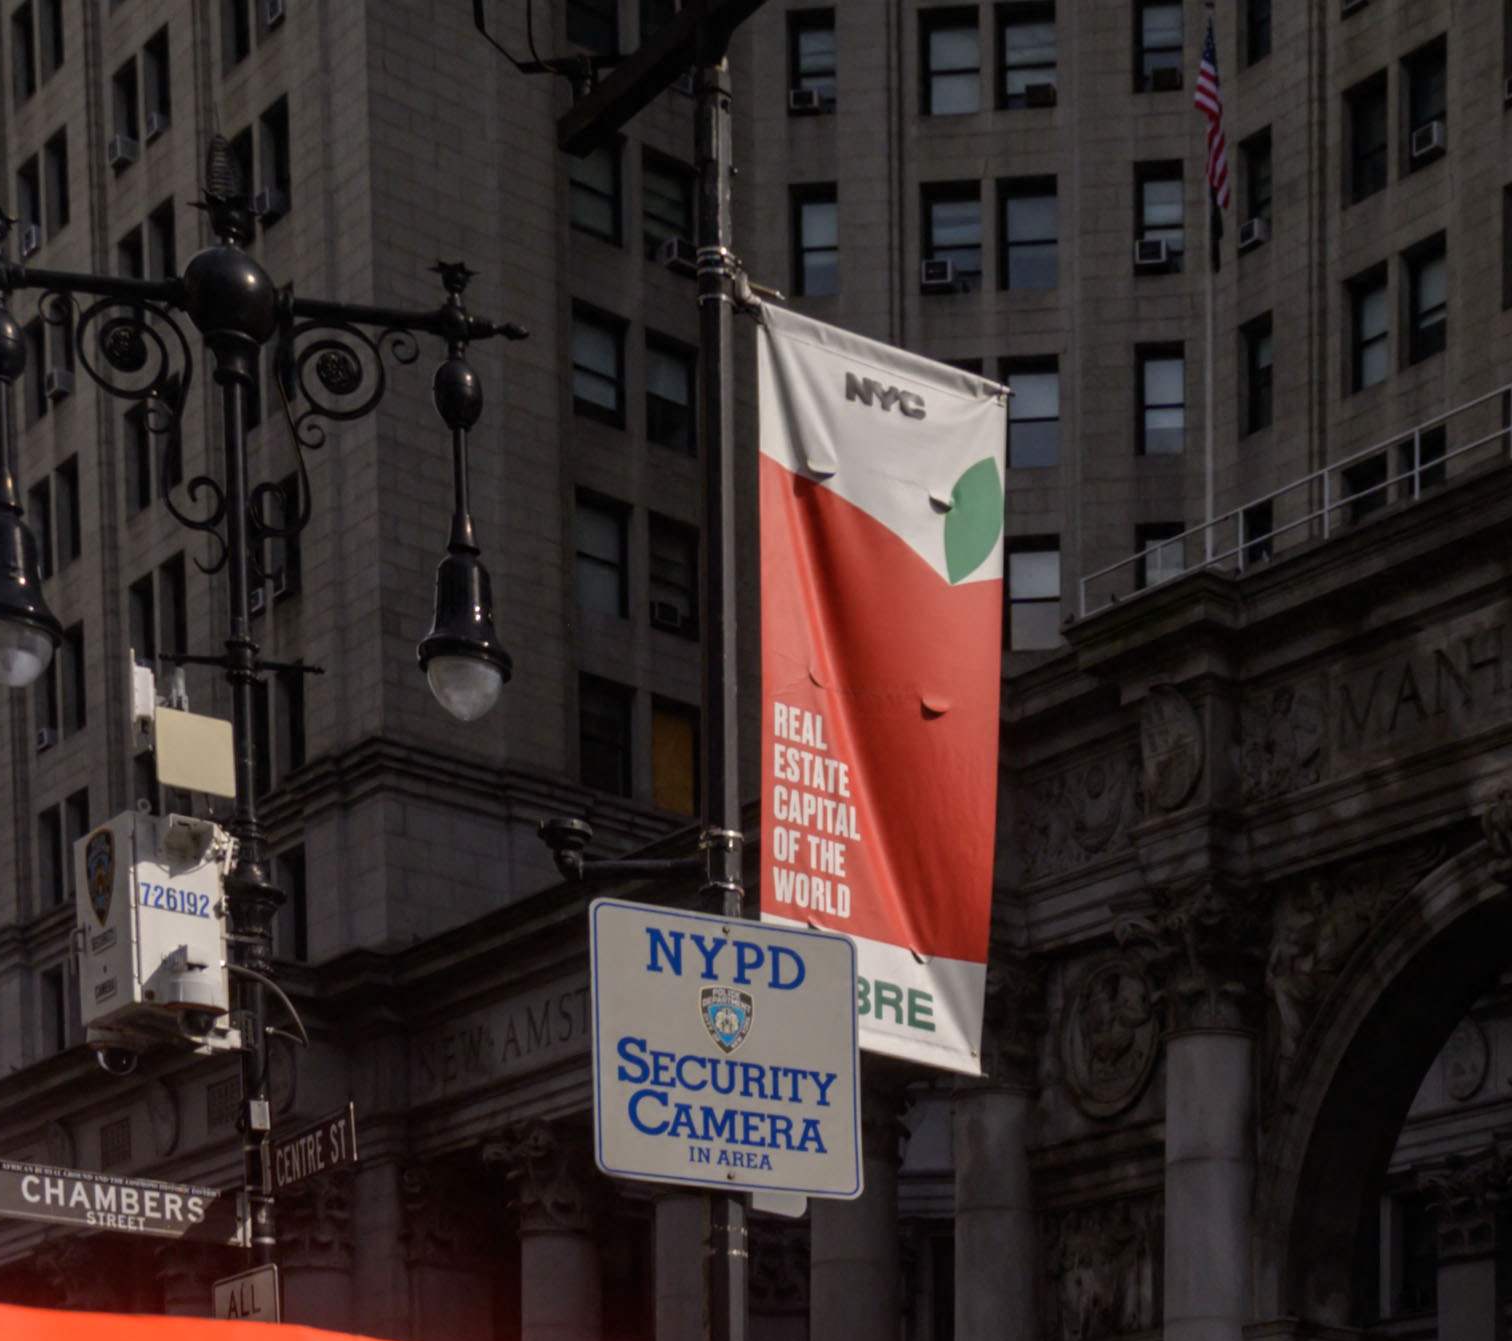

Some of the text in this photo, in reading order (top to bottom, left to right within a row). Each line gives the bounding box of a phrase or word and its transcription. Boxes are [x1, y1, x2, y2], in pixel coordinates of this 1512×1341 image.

[844, 371, 926, 421] NYC
[773, 701, 827, 753] REAL
[773, 747, 851, 799] ESTATE
[773, 791, 861, 842] CAPITAL
[773, 833, 846, 878] OF THE
[140, 882, 210, 918] 726192
[773, 866, 852, 920] WORLD
[646, 928, 806, 991] NYPD
[617, 1037, 837, 1107] SECURITY
[629, 1090, 828, 1155] CAMERA
[275, 1118, 347, 1188] CENTRE ST
[689, 1146, 773, 1172] IN AREA
[21, 1175, 205, 1223] CHAMBERS
[86, 1210, 146, 1232] STREET
[228, 1284, 262, 1317] ALL
